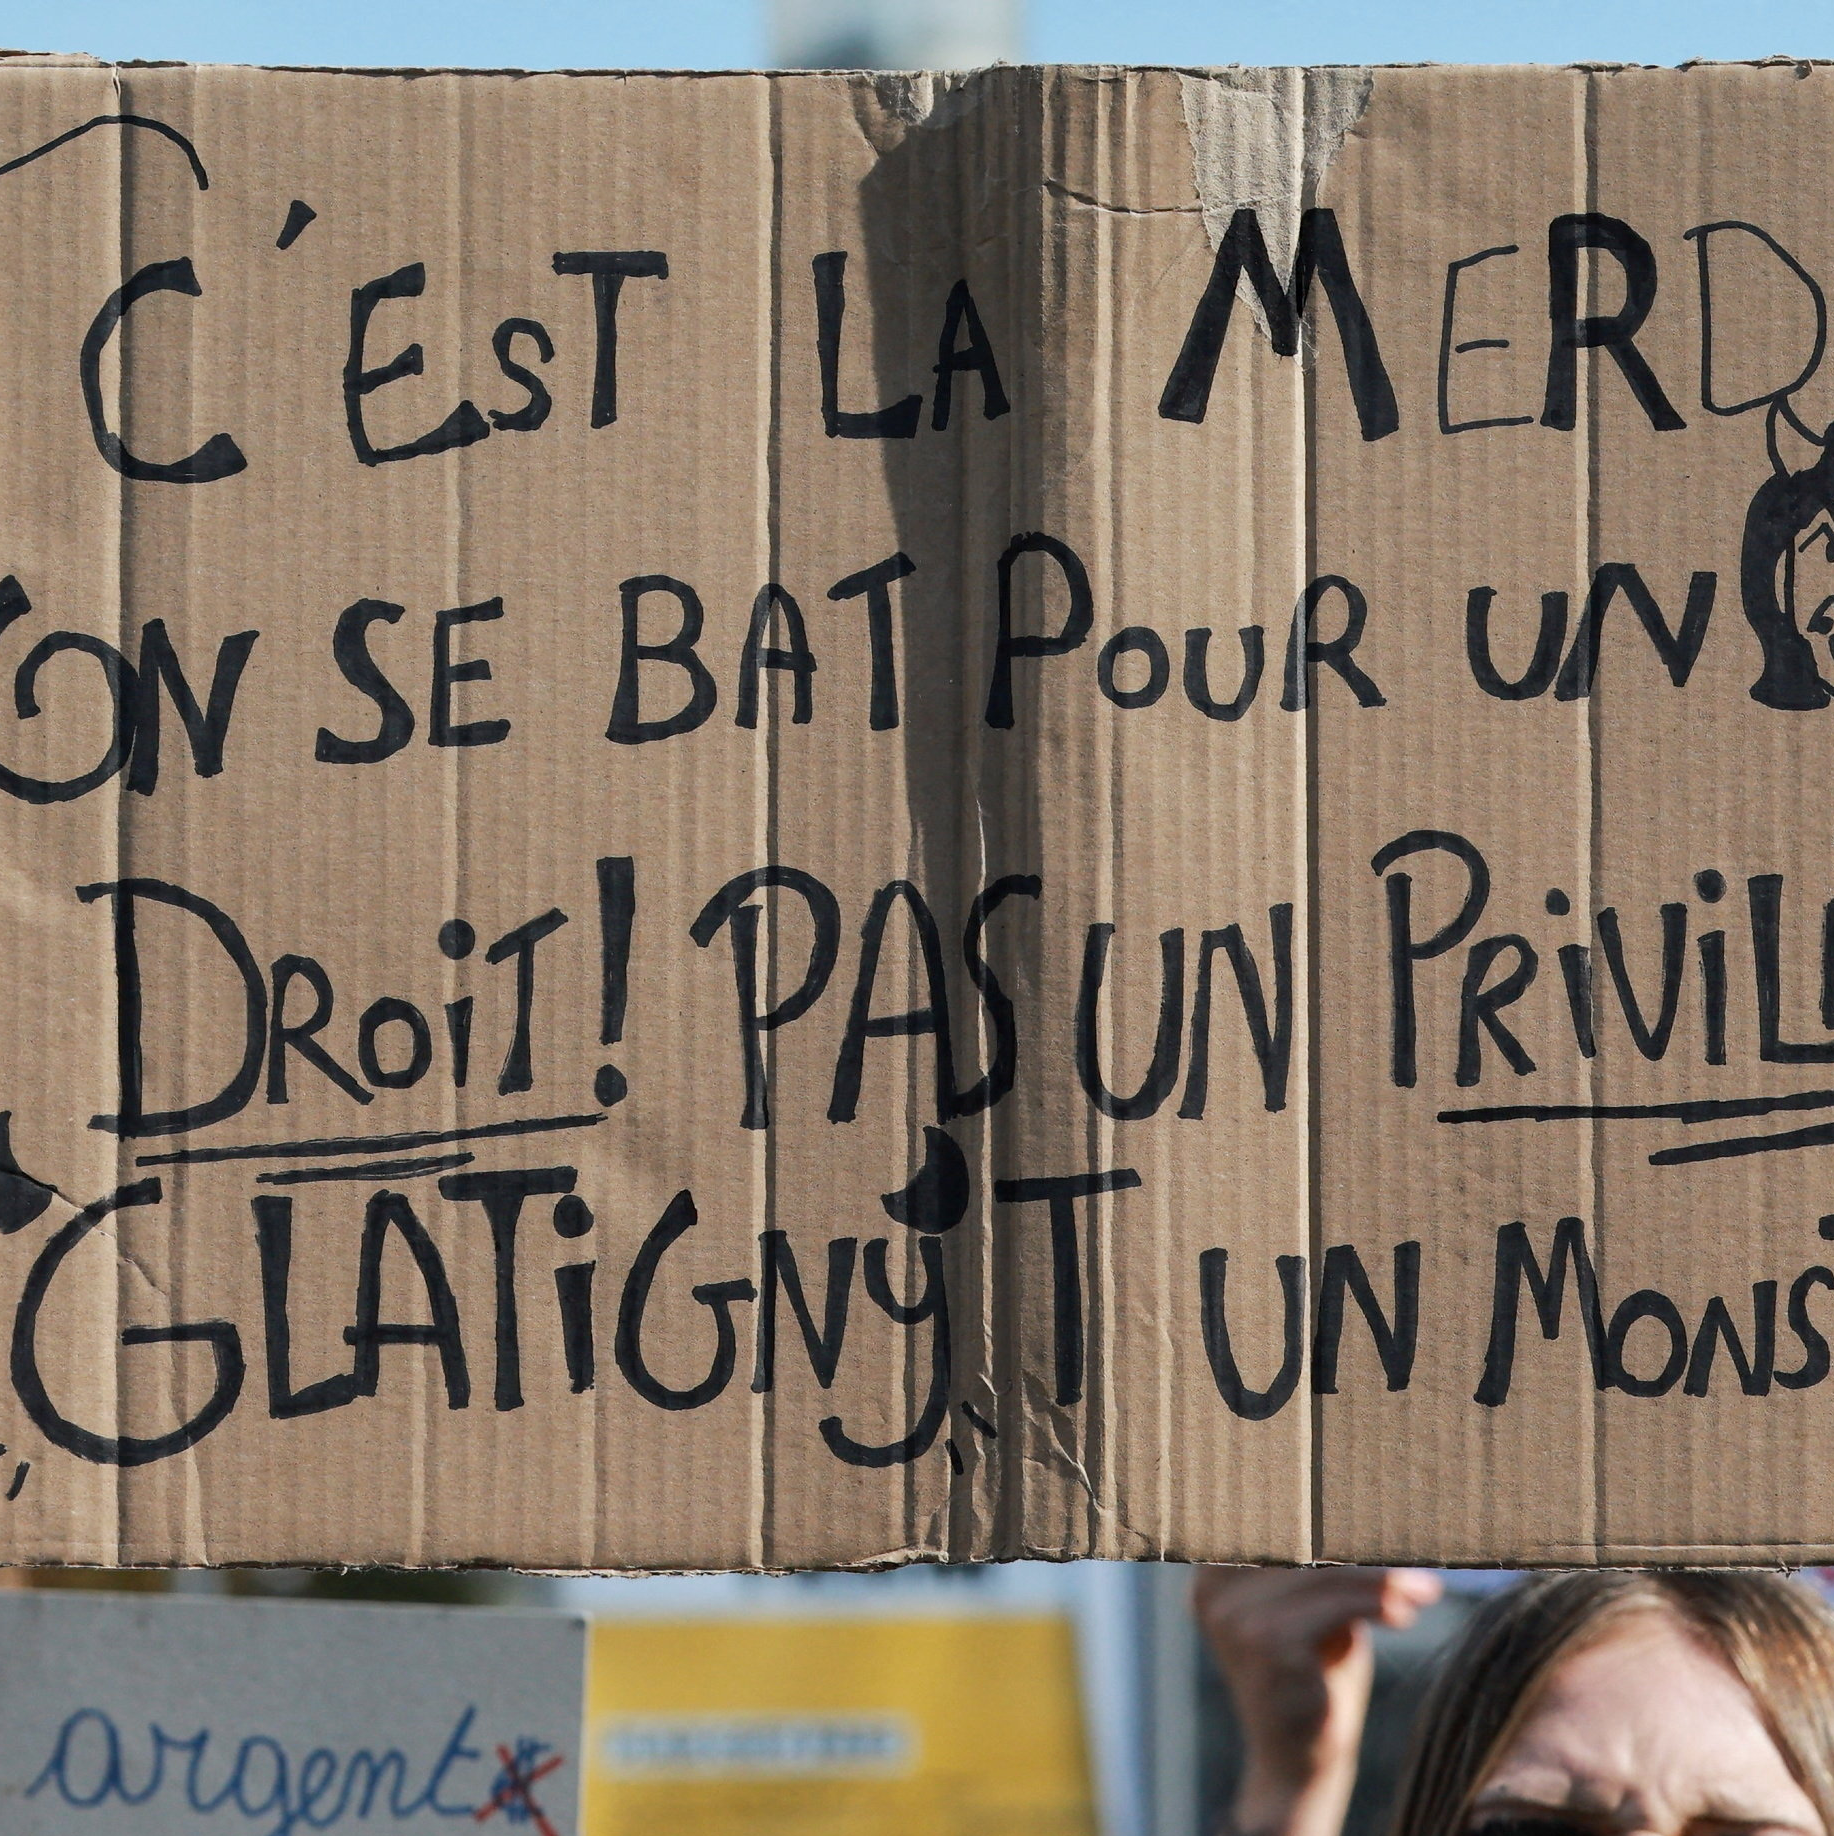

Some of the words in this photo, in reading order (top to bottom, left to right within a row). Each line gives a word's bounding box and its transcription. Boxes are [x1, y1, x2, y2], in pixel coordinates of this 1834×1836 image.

[812, 249, 1011, 440] LA
[314, 595, 513, 766] SE
[605, 550, 917, 745] BAT
[1465, 561, 1719, 703] UN
[688, 863, 1044, 1131] PAS
[1075, 901, 1295, 1122] UN
[1198, 1238, 1422, 1421] UN
